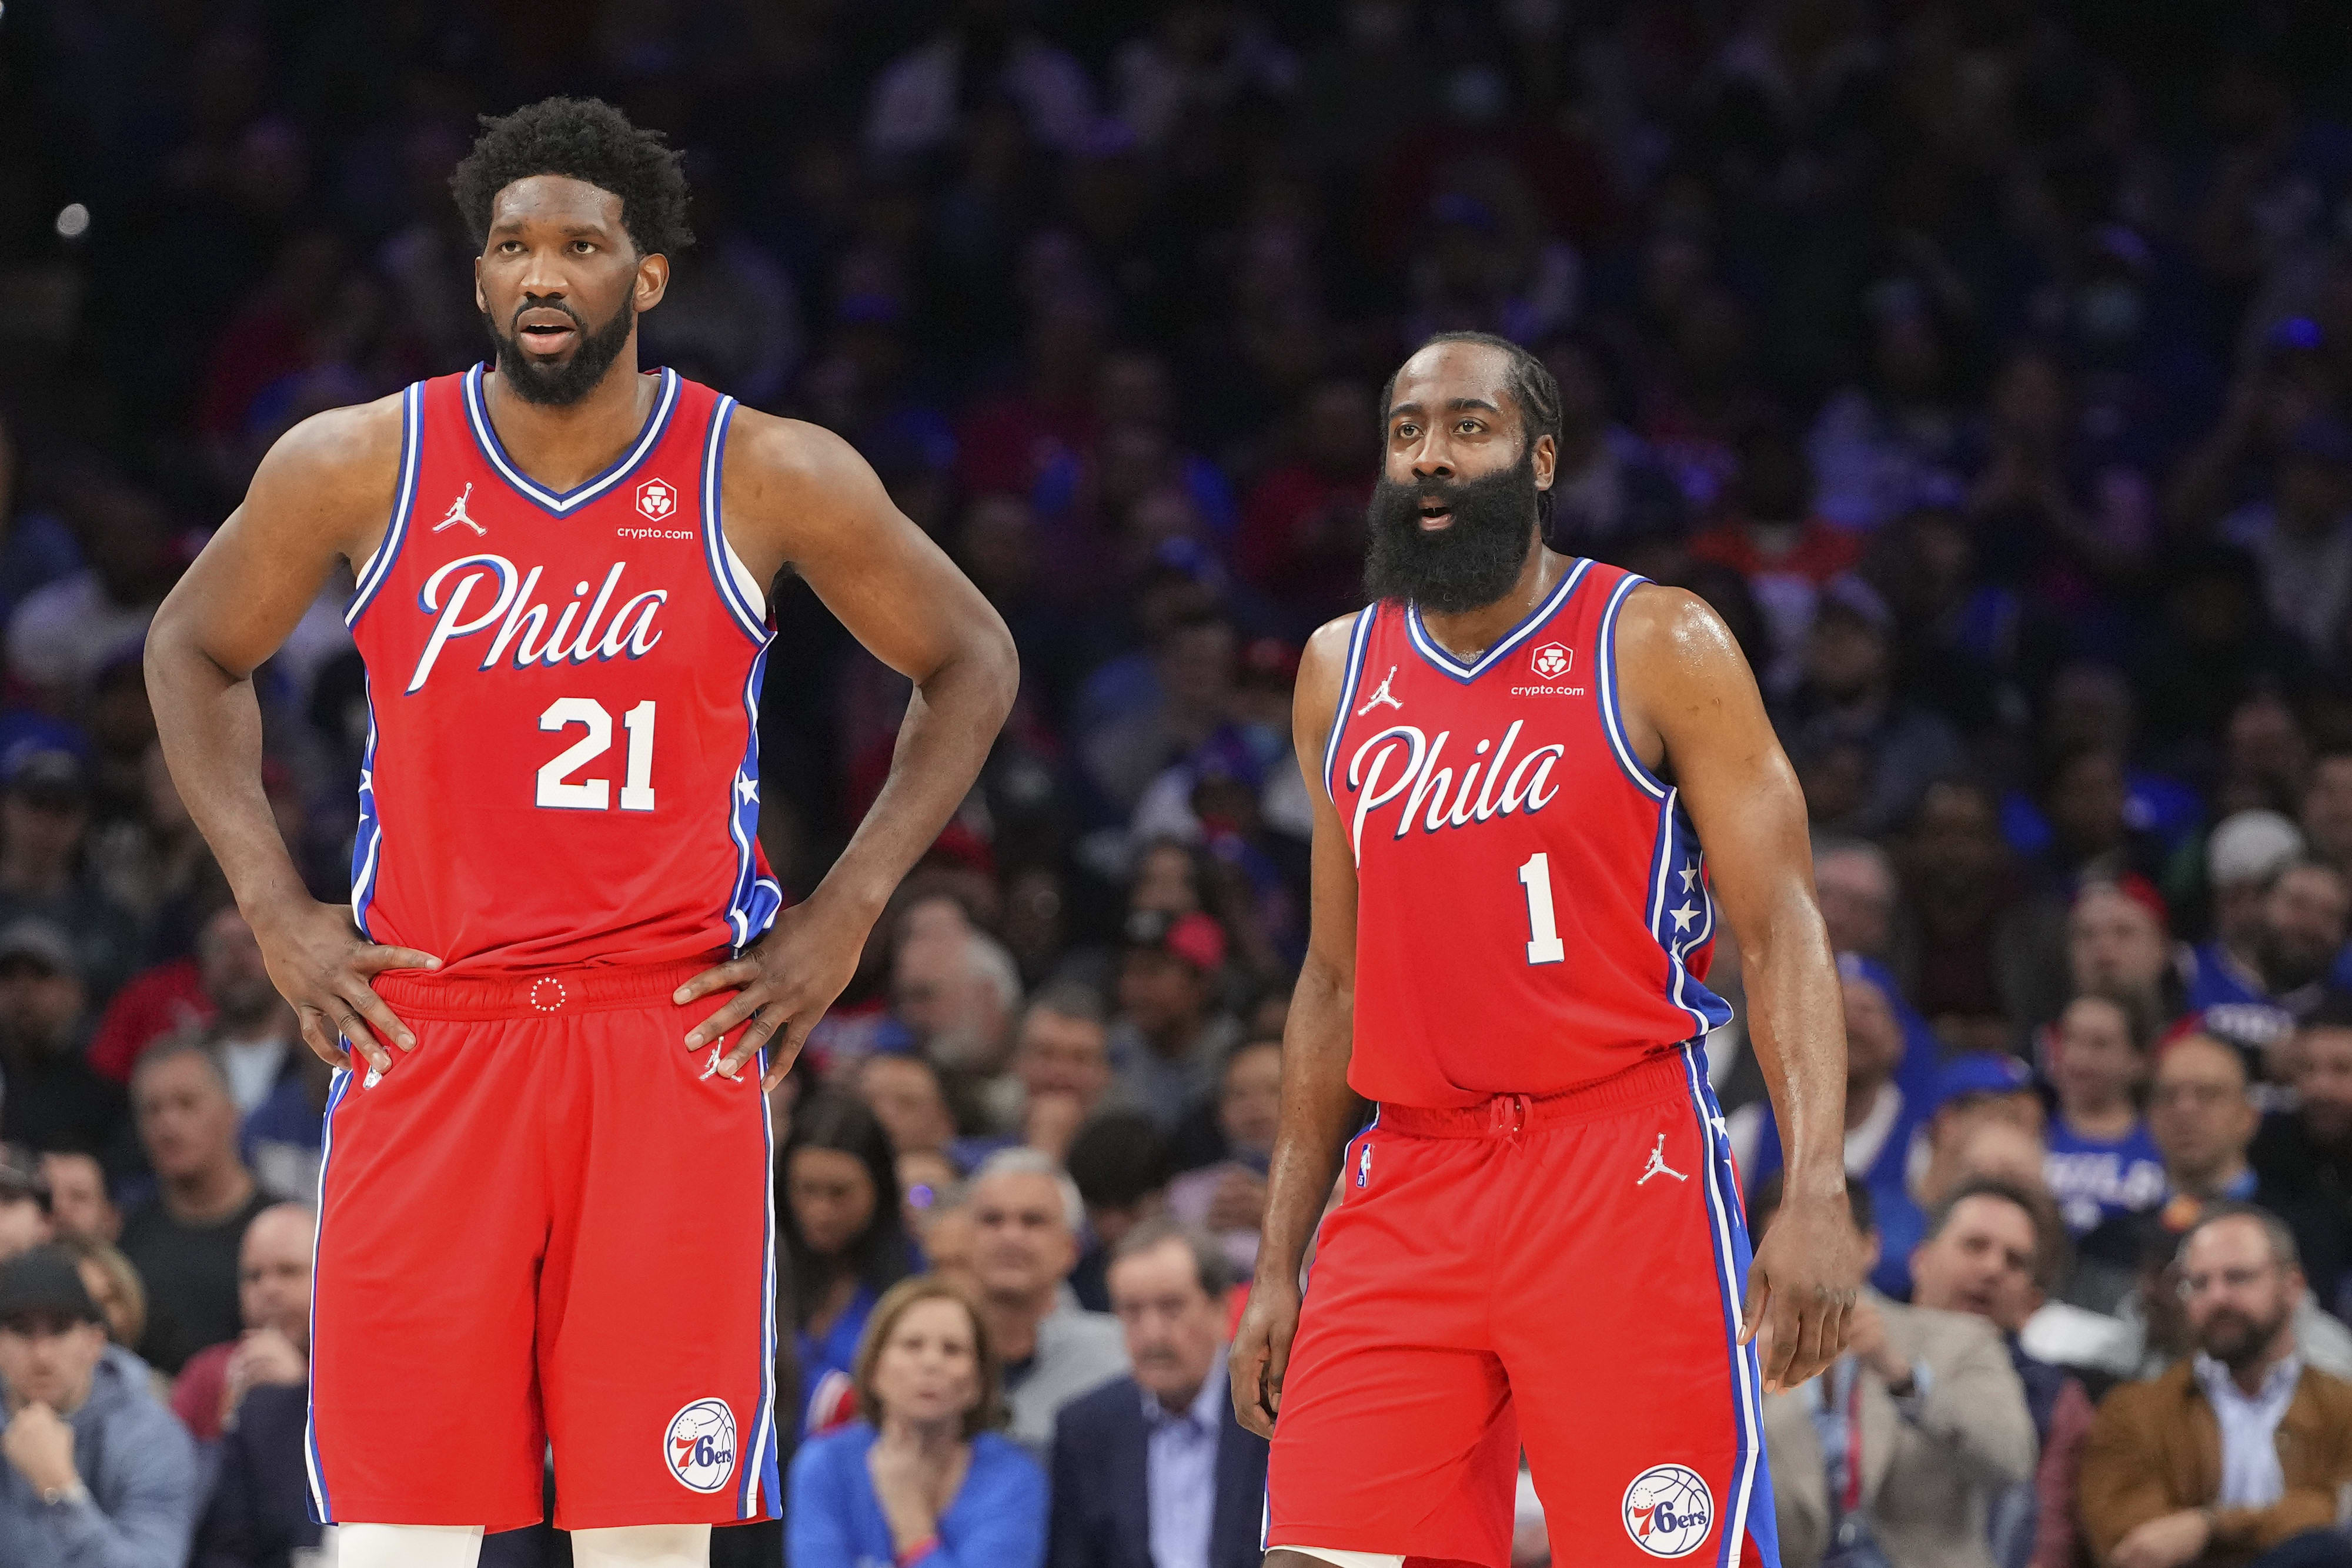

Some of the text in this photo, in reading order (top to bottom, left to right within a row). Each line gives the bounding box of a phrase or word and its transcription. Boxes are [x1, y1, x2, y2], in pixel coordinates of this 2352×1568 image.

[617, 527, 693, 540] crypto.com
[404, 553, 667, 696] Phila
[1511, 684, 1585, 697] crypto.com
[534, 697, 656, 812] 21
[1346, 719, 1565, 870] Phila
[1518, 852, 1565, 965] 1
[676, 1435, 731, 1469] 76ers
[1633, 1501, 1707, 1537] 76ers
